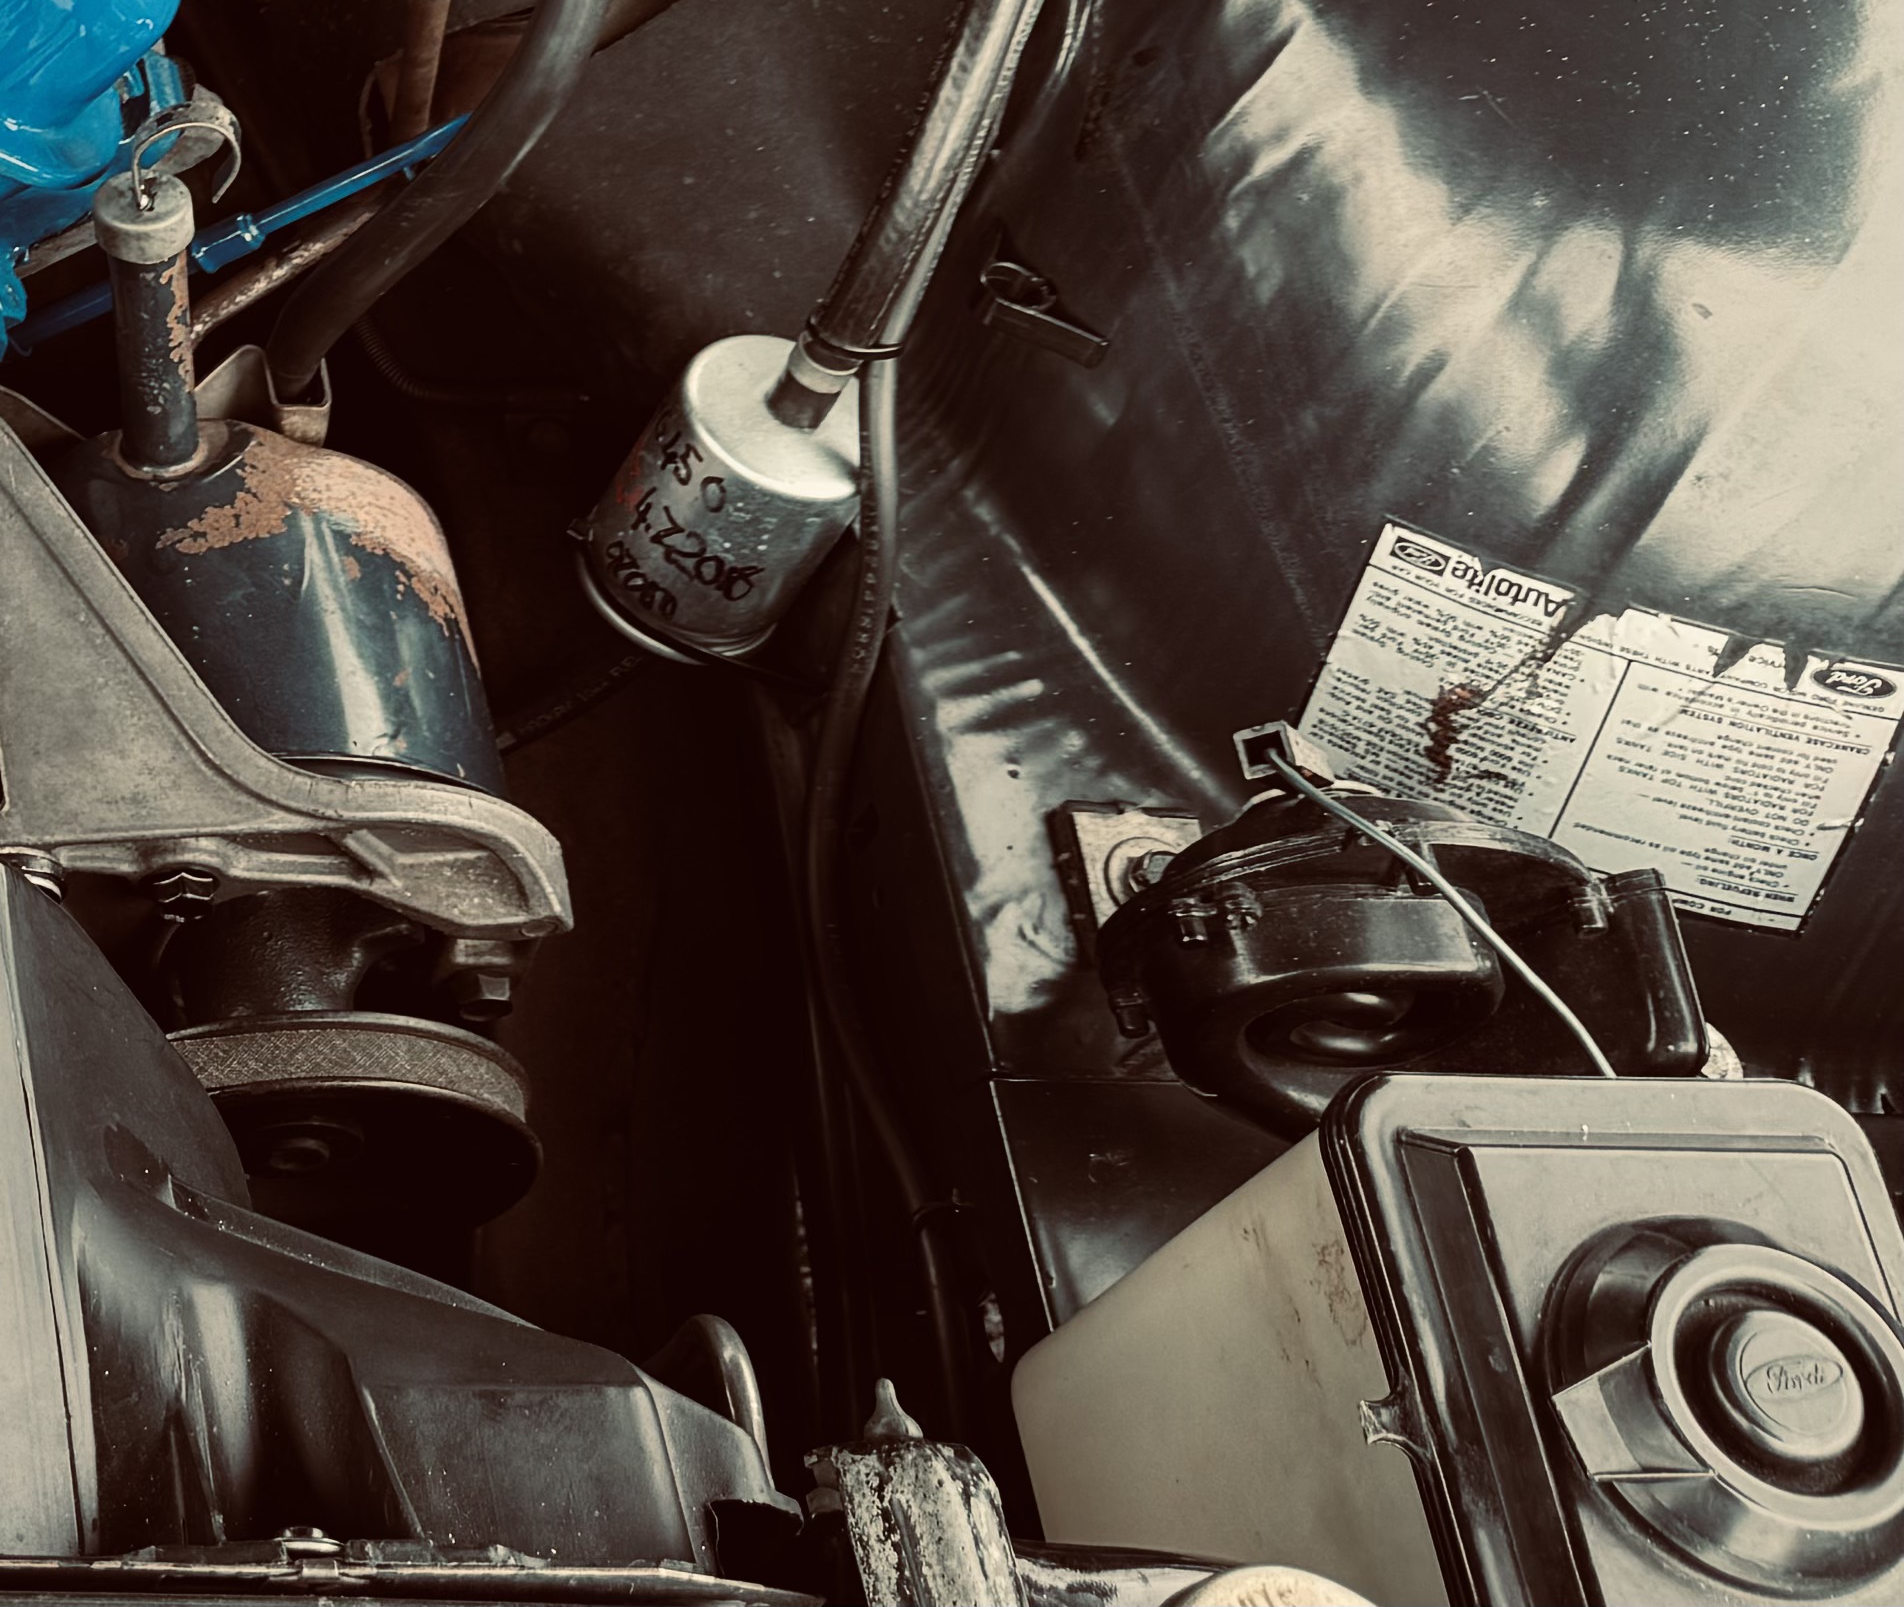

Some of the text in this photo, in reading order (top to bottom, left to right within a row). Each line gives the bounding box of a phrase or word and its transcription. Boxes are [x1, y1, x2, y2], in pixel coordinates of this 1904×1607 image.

[1447, 558, 1567, 620] Autolite
[1823, 667, 1879, 699] Ford
[1728, 720, 1800, 741] VENTILATION
[1805, 737, 1870, 755] CRANKCASE
